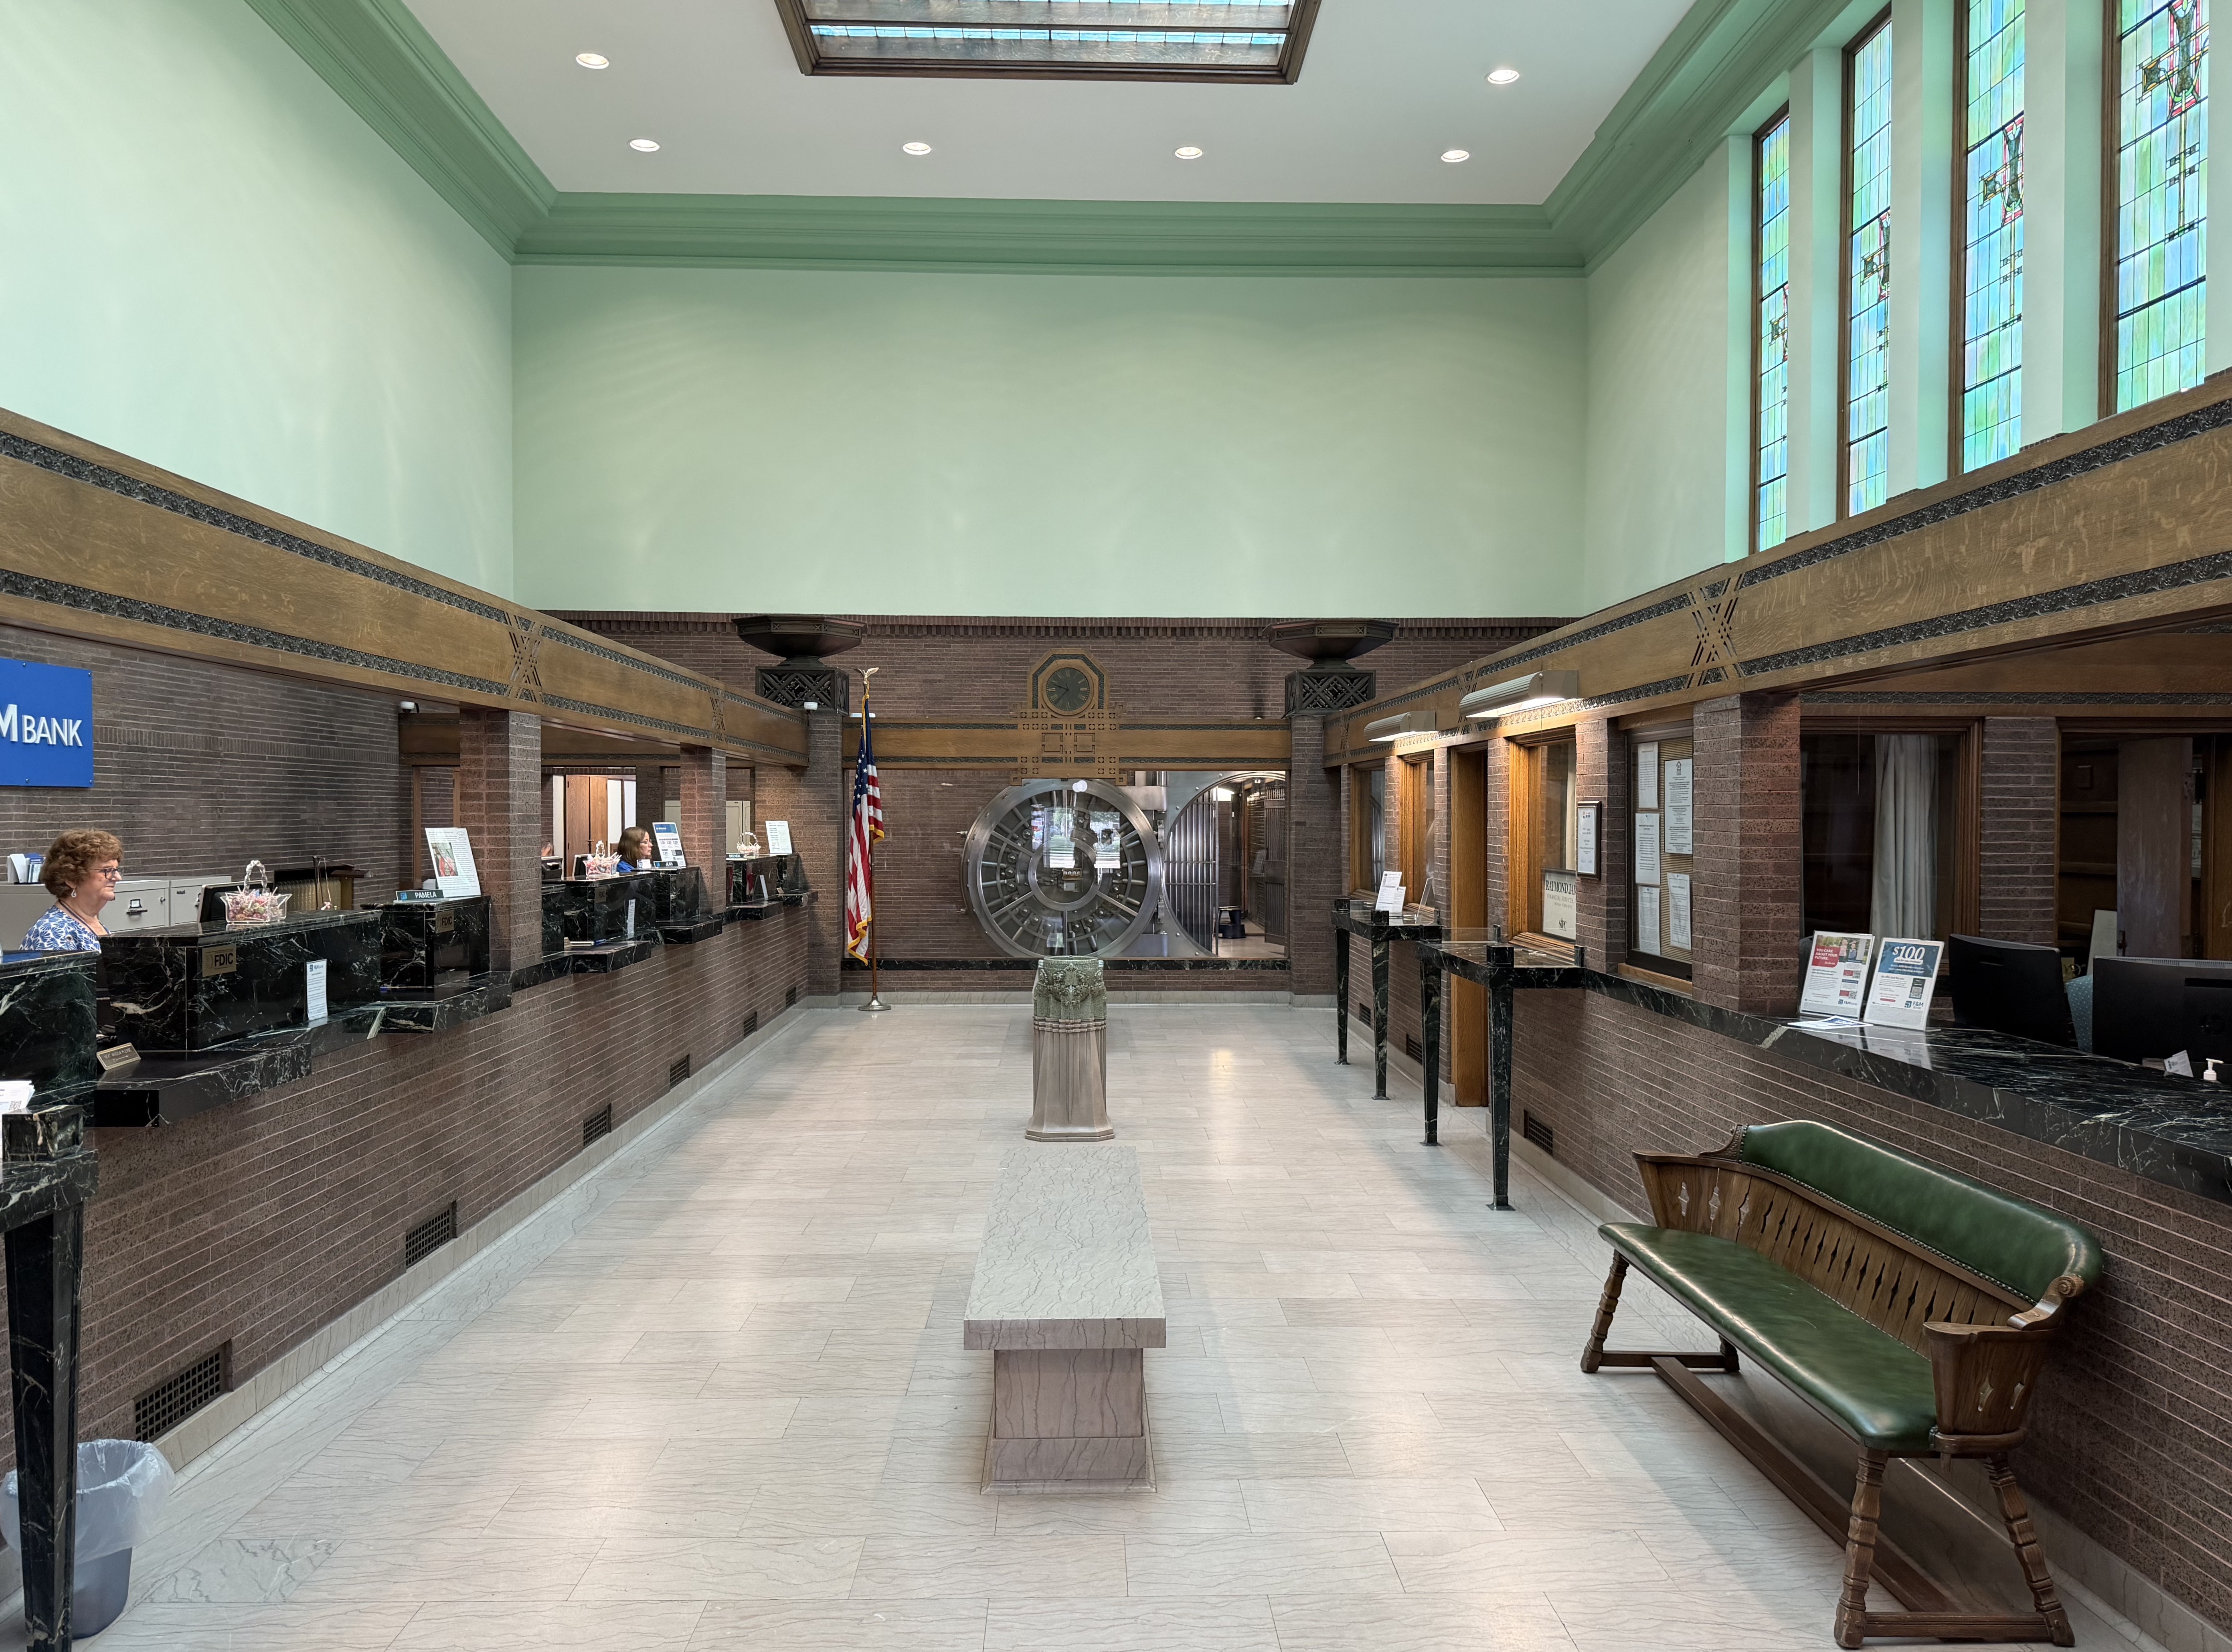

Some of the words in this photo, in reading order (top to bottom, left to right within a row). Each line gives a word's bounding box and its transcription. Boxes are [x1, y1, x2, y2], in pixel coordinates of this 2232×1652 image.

[22, 715, 83, 747] BANK
[1546, 880, 1568, 893] RAYMOND
[442, 916, 452, 926] FDIC
[214, 952, 233, 967] FDIC
[1892, 946, 1925, 960] $100
